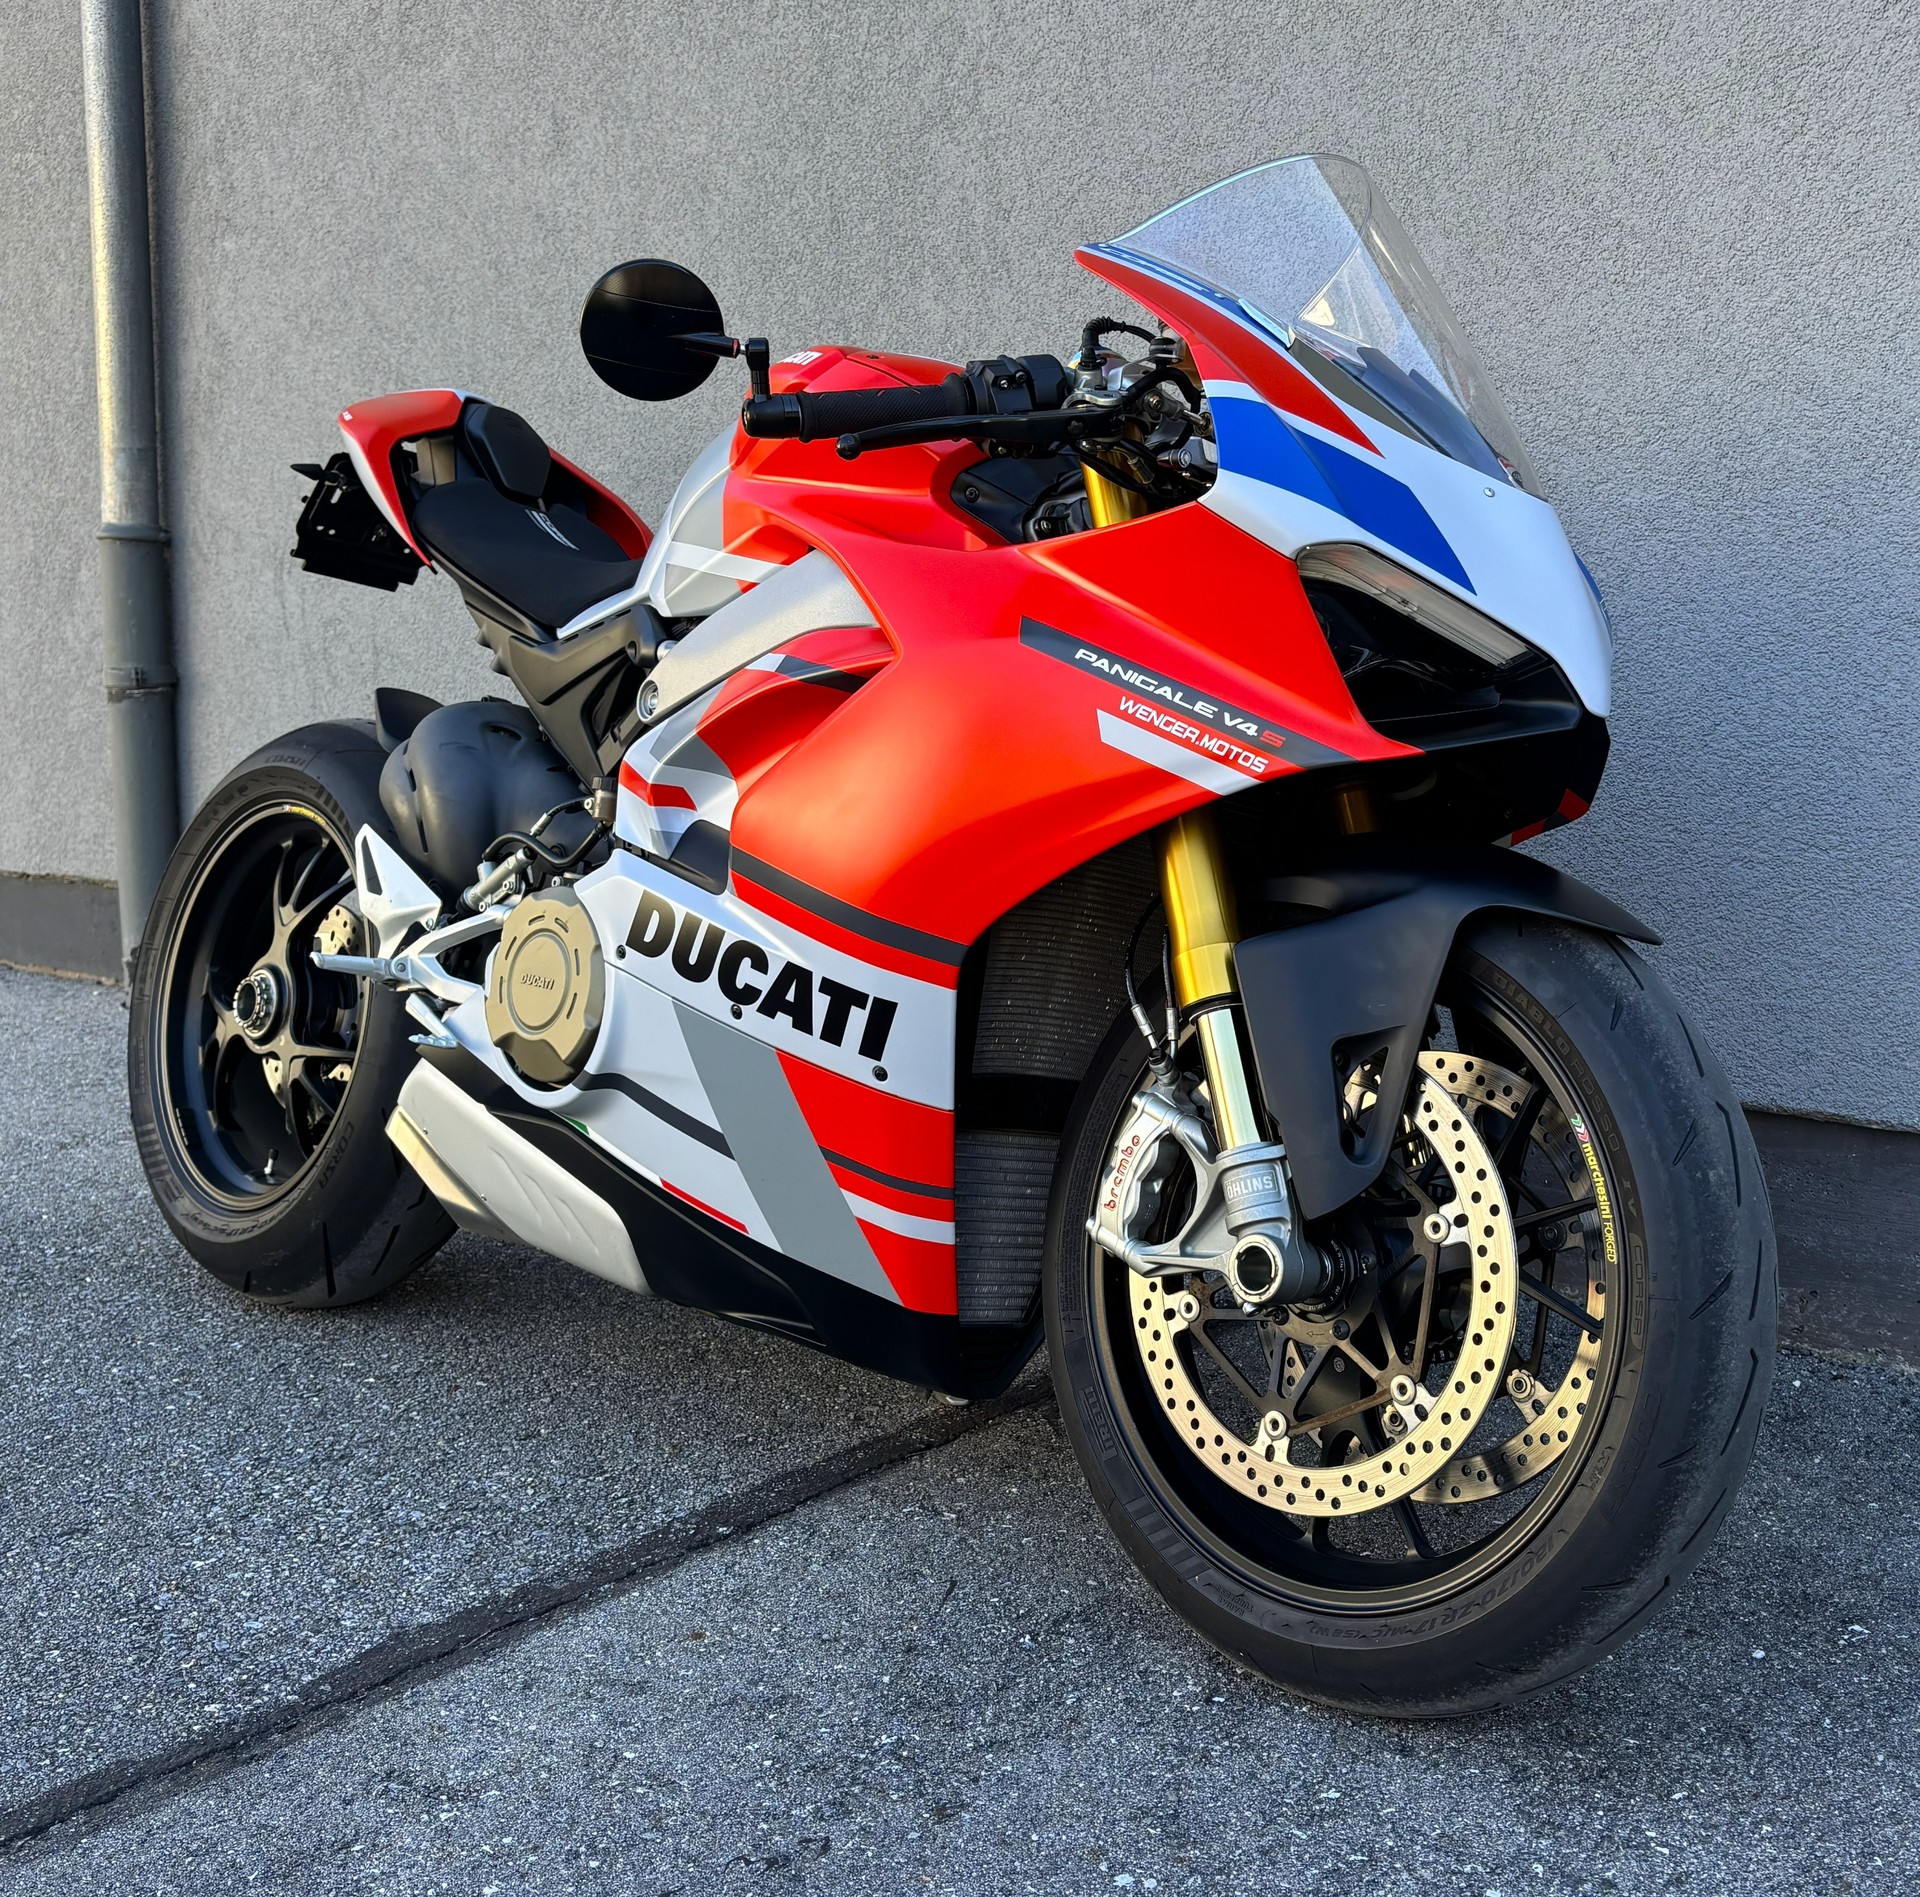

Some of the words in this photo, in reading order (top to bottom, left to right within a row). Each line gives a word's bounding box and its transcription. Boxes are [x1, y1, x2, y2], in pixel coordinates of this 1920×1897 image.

[1075, 648, 1218, 719] PANIGALE
[1119, 696, 1270, 773] WENGER.MOTOS
[520, 973, 556, 990] DUCATI
[625, 889, 899, 1062] DUCATI
[1104, 1134, 1141, 1212] brembo
[1225, 1174, 1273, 1198] ÖHLINS
[1494, 970, 1571, 1057] DIABLO
[1570, 1060, 1620, 1152] ROSSO
[1633, 1245, 1645, 1336] CORSA
[1581, 1142, 1614, 1220] marchesini
[1603, 1220, 1618, 1265] FORGED
